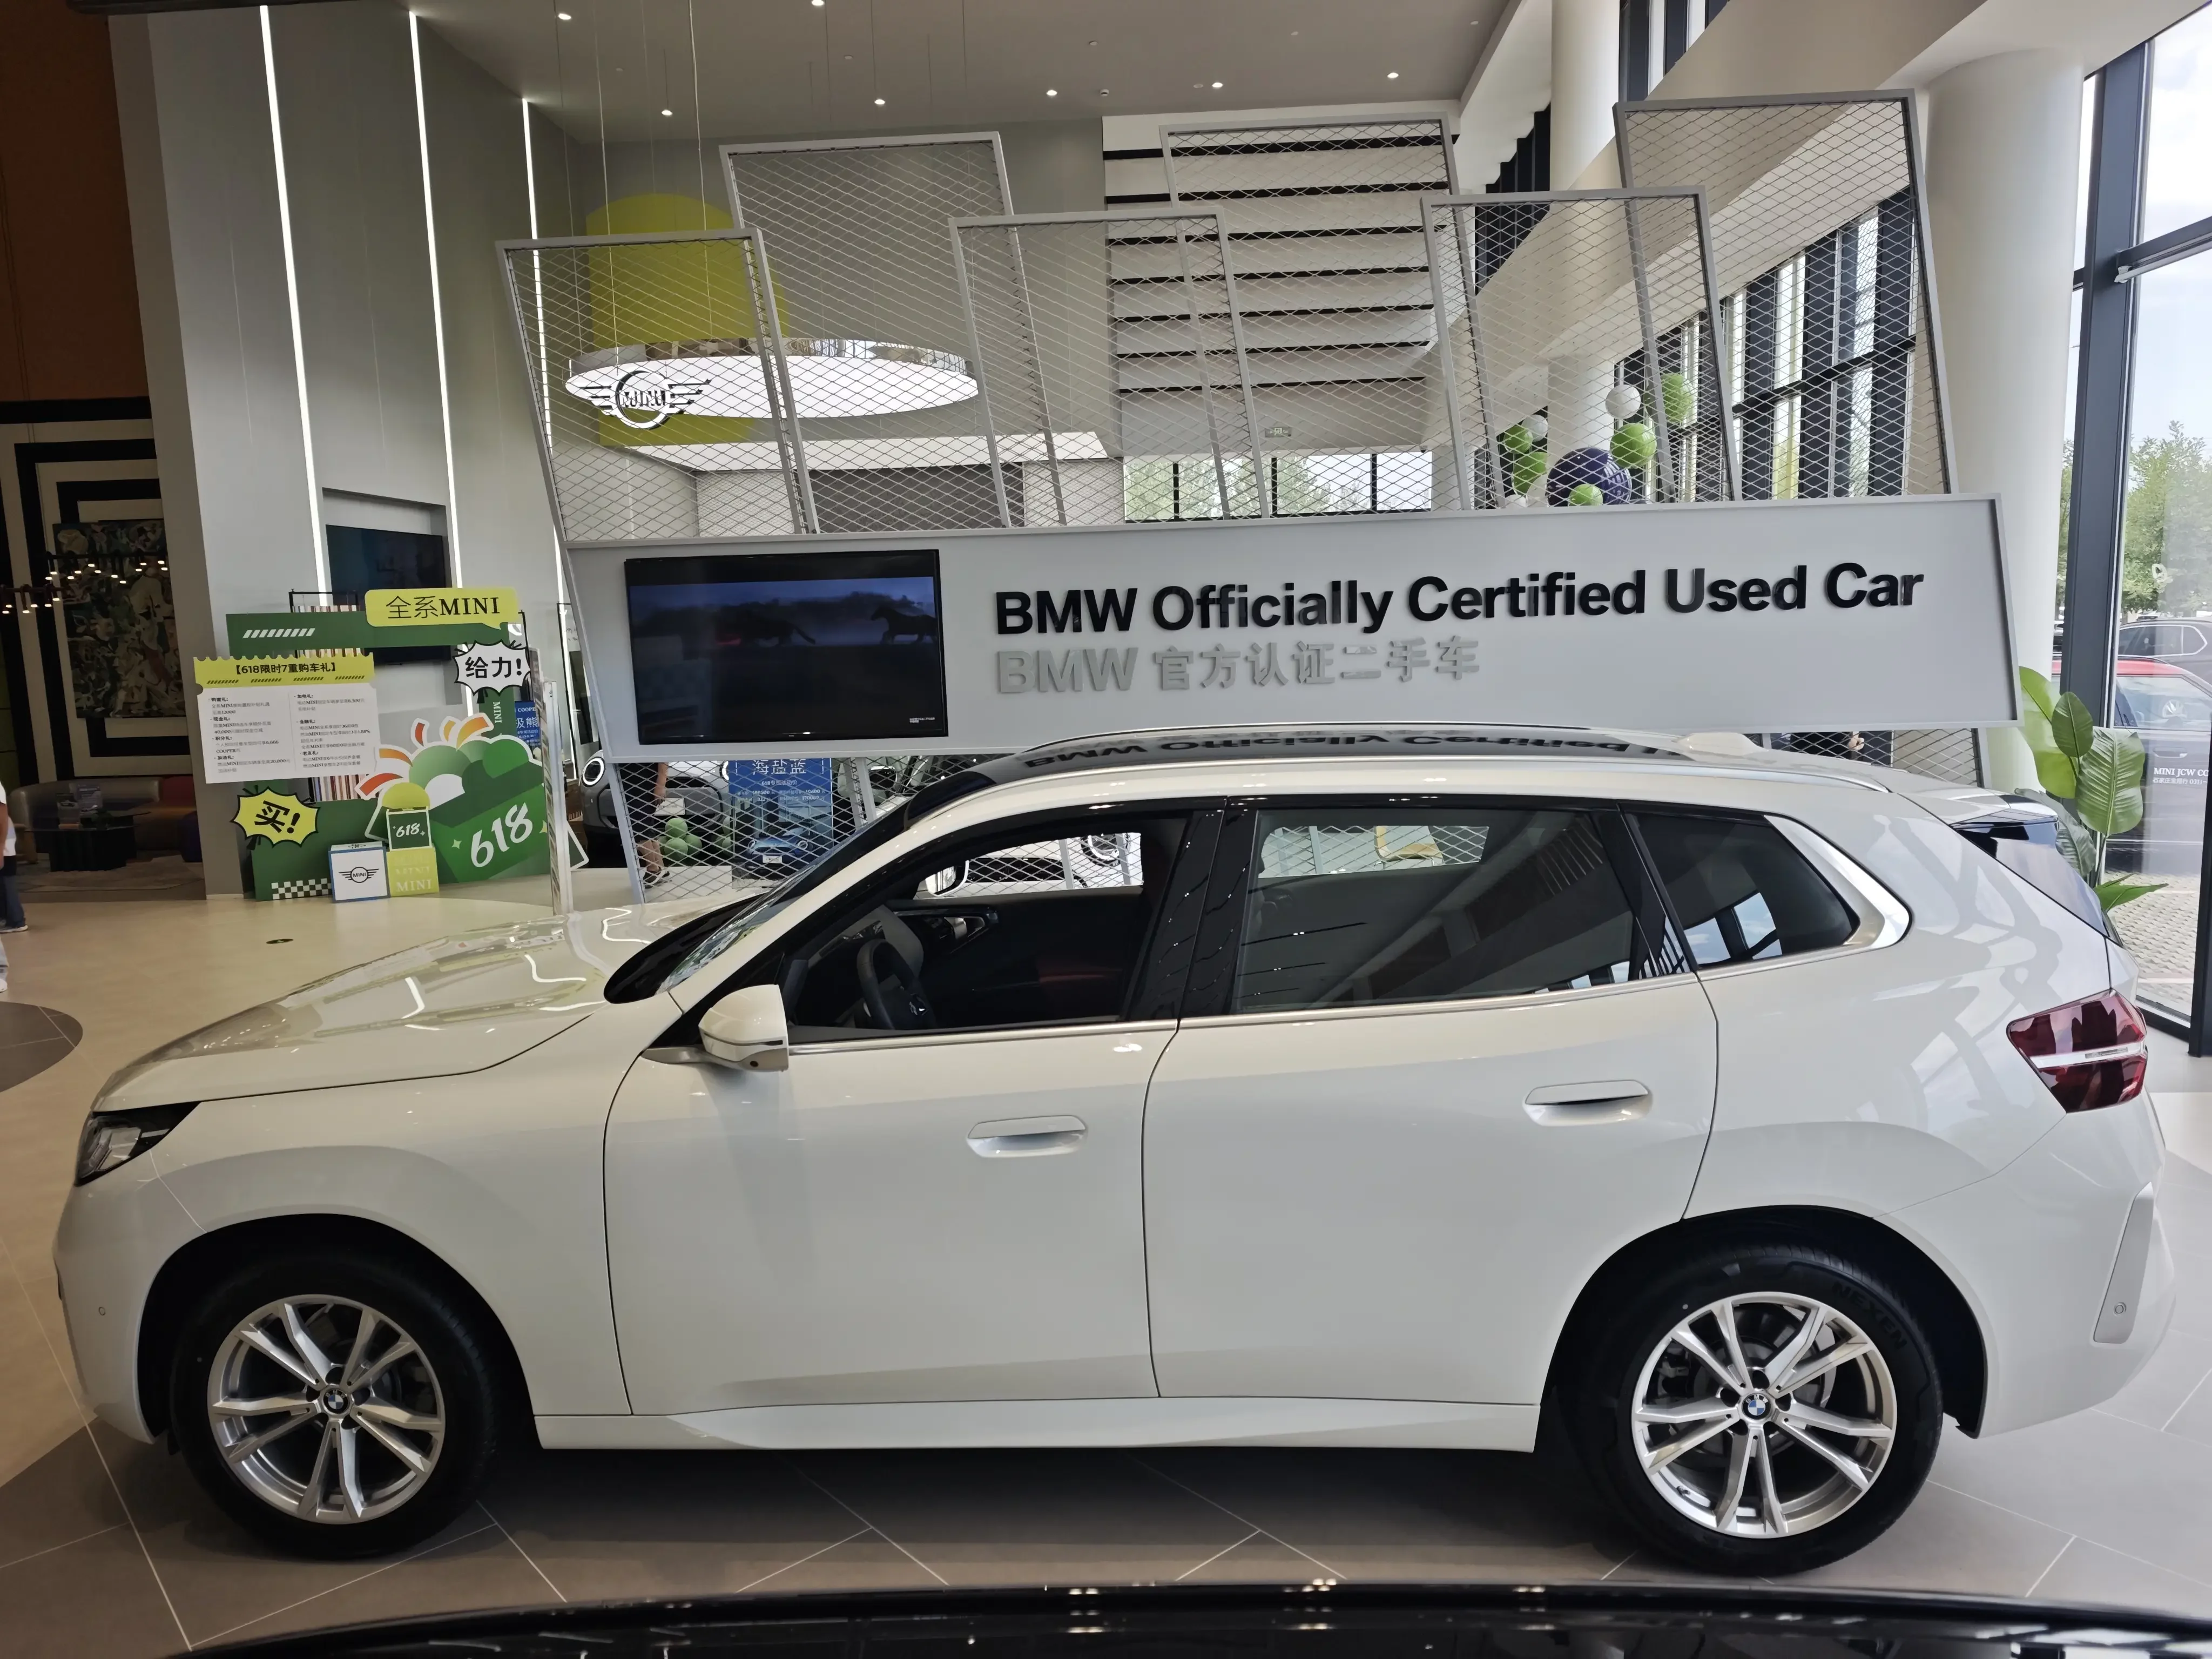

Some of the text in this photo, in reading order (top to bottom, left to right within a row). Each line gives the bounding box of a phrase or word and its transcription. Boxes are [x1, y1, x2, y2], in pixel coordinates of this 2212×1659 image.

[619, 389, 666, 407] MINI
[386, 596, 500, 619] 全系MINI
[996, 562, 1924, 635] BMW Officially Certified Used Car
[465, 656, 522, 678] 给力!
[999, 635, 1480, 693] BMW 官方认证二手车
[493, 702, 502, 723] MINI
[2176, 768, 2196, 777] JCW
[254, 800, 300, 834] 买!
[396, 822, 420, 838] 618
[471, 802, 533, 868] 618
[396, 879, 431, 893] MINI
[1832, 1281, 1907, 1350] NEXEN
